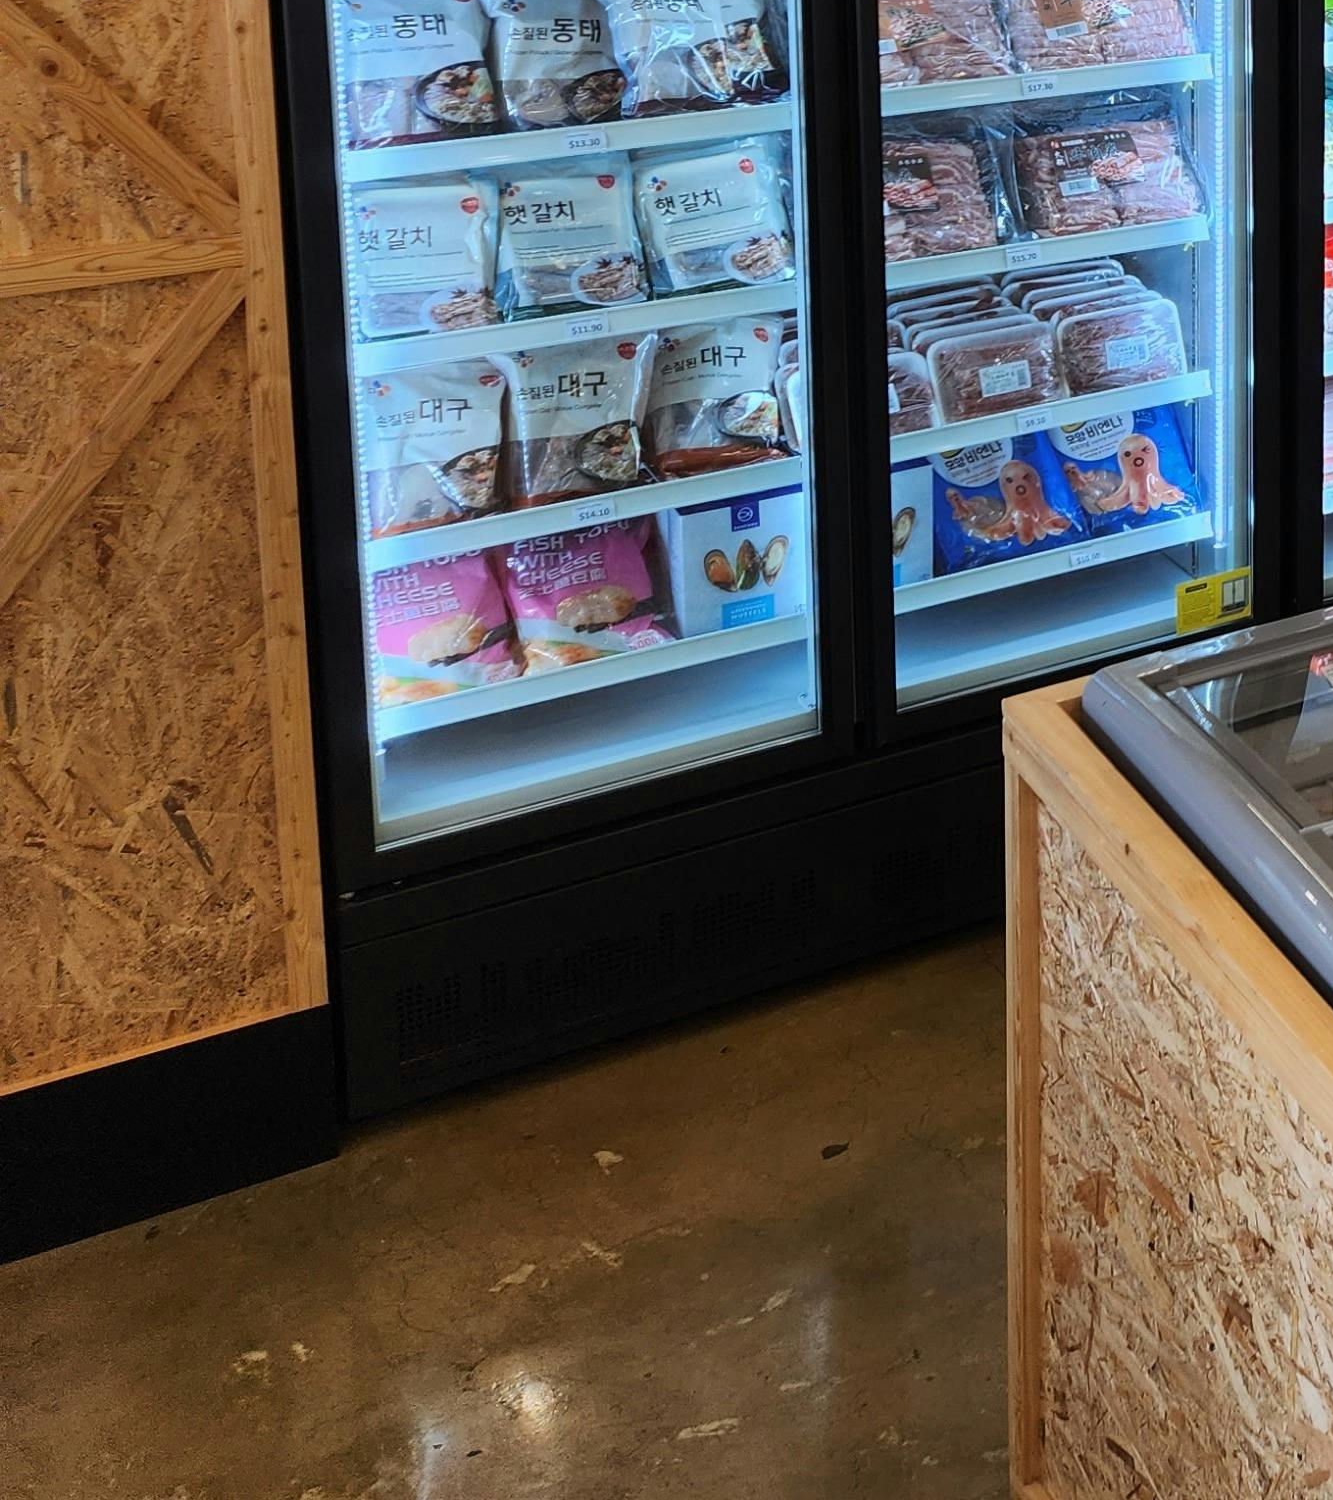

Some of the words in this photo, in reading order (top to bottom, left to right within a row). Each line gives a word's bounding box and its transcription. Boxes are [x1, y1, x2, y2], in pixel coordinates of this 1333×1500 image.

[391, 12, 448, 39] 동태
[511, 26, 548, 41] 손질된
[550, 16, 601, 44] 동태
[503, 203, 527, 226] 햇
[531, 199, 576, 223] 갈치
[654, 195, 677, 216] 햇
[679, 187, 723, 214] 갈치
[357, 229, 380, 253] 햇
[385, 225, 433, 251] 갈치
[660, 358, 697, 376] 손질된
[700, 345, 747, 369] 대구
[515, 385, 555, 401] 손질된
[557, 370, 609, 398] 대구
[376, 412, 416, 429] 손질된
[419, 398, 473, 424] 대구
[1087, 415, 1124, 438] 비엔나
[513, 535, 565, 556] FISH
[515, 551, 574, 572] WITH
[517, 552, 604, 588] CHEESE
